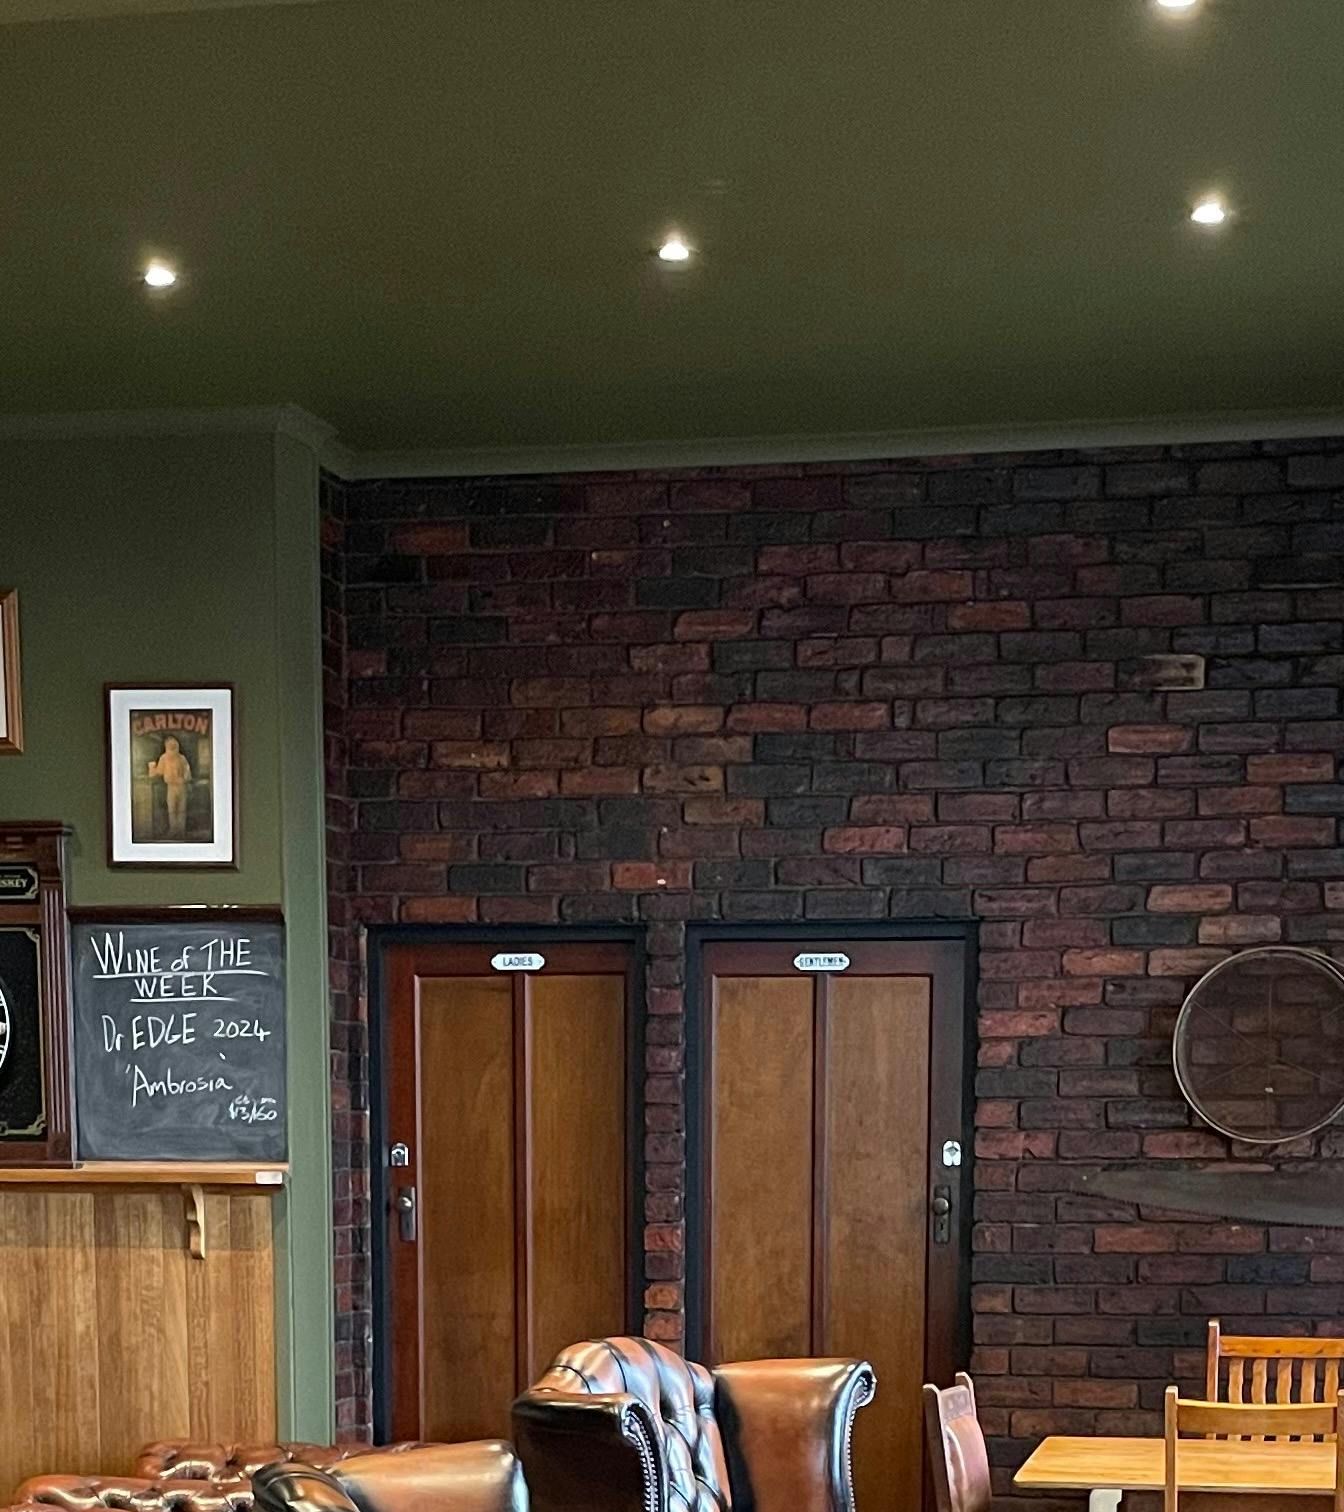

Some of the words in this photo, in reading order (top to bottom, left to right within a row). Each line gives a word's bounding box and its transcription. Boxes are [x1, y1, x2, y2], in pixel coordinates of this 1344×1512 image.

[132, 712, 209, 735] CARLTON
[90, 931, 163, 976] WINE
[170, 945, 195, 972] of
[200, 937, 252, 971] THE
[502, 956, 533, 967] LADIES
[134, 973, 219, 999] WEEK
[101, 1014, 124, 1053] Dr
[131, 1012, 198, 1051] EDGE
[212, 1018, 272, 1042] 2024
